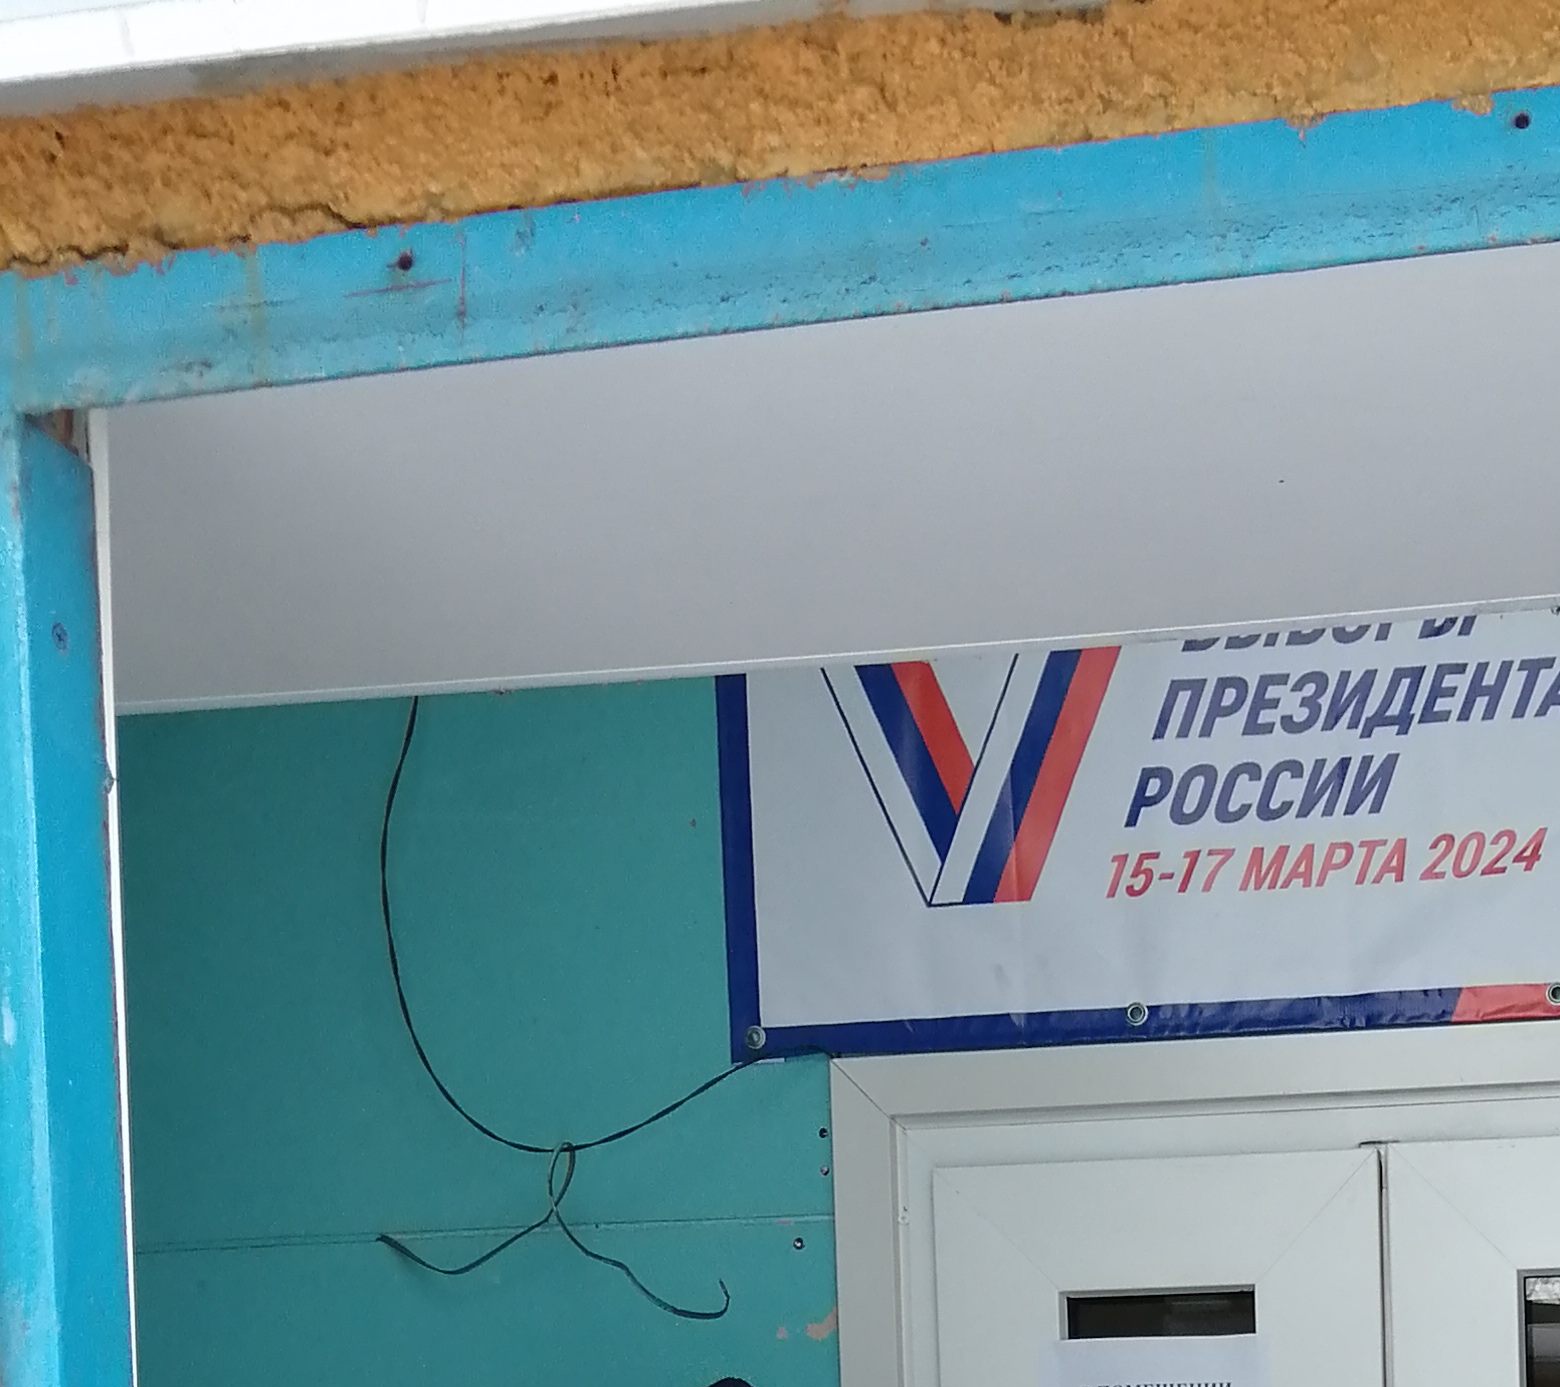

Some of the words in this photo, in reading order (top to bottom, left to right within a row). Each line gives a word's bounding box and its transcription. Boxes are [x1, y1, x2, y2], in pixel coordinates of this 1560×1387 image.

[1124, 753, 1400, 828] РОССИИ
[1105, 847, 1235, 899] 15-17
[1240, 837, 1408, 892] МАРТА
[1428, 827, 1548, 881] 2024
